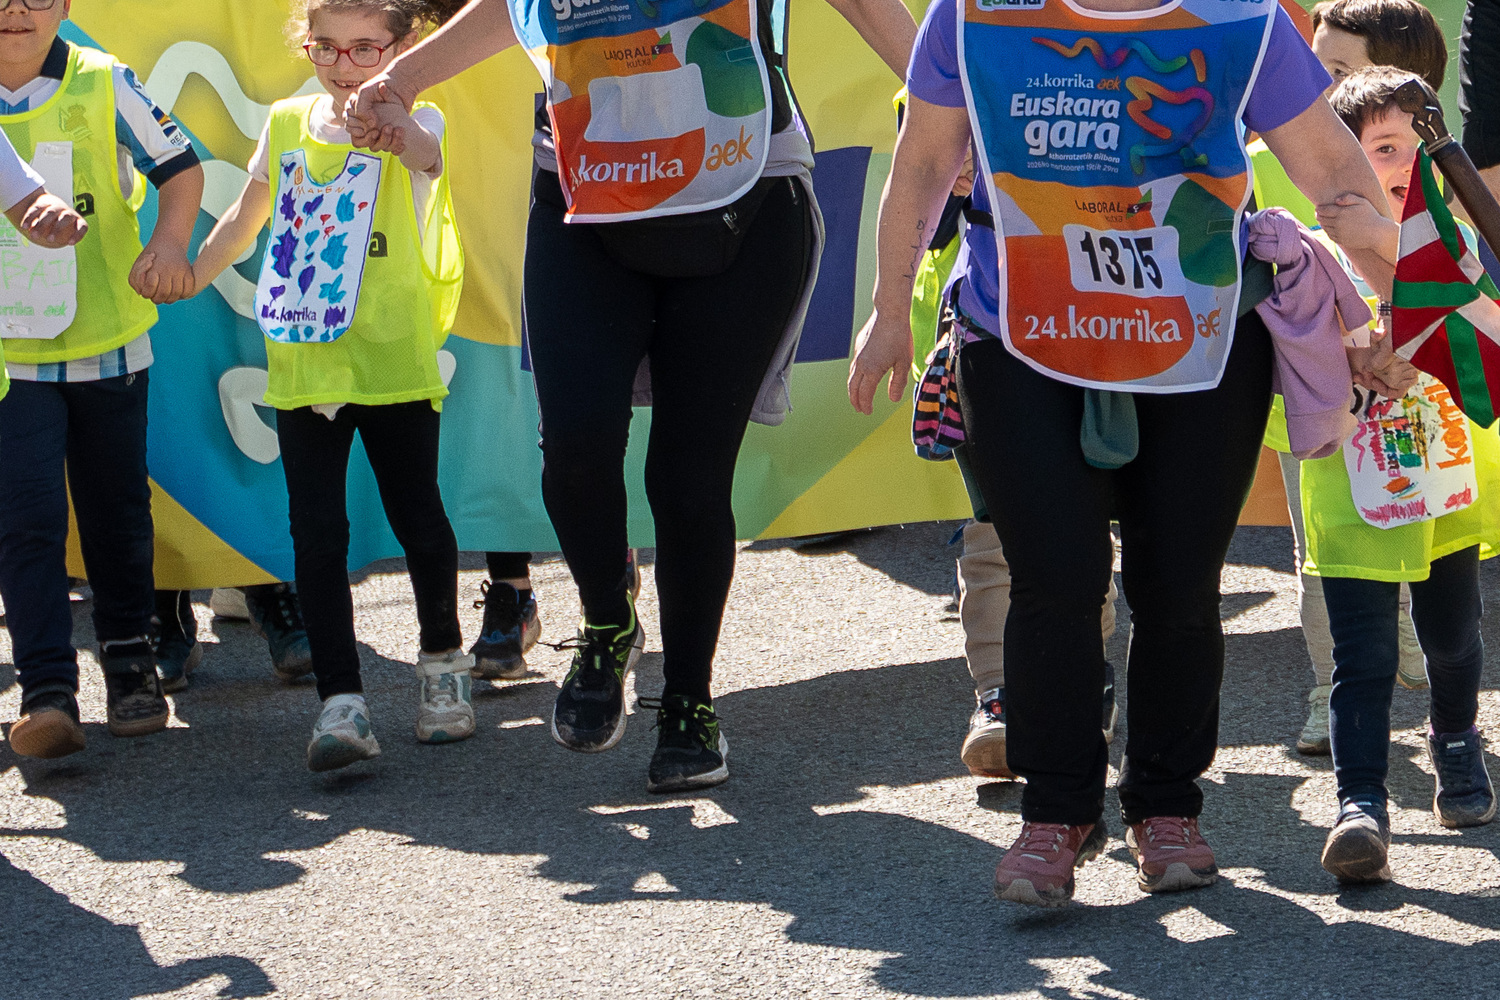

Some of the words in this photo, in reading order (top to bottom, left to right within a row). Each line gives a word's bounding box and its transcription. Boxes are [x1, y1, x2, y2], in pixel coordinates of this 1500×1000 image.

[1026, 73, 1094, 90] 24.korrika
[1096, 77, 1121, 91] aek
[1010, 90, 1120, 119] Euskara
[705, 125, 754, 172] aek
[1024, 118, 1120, 156] gara
[1075, 200, 1124, 214] LABORAL
[1080, 231, 1164, 290] 1375
[1024, 305, 1183, 343] 24.korrika
